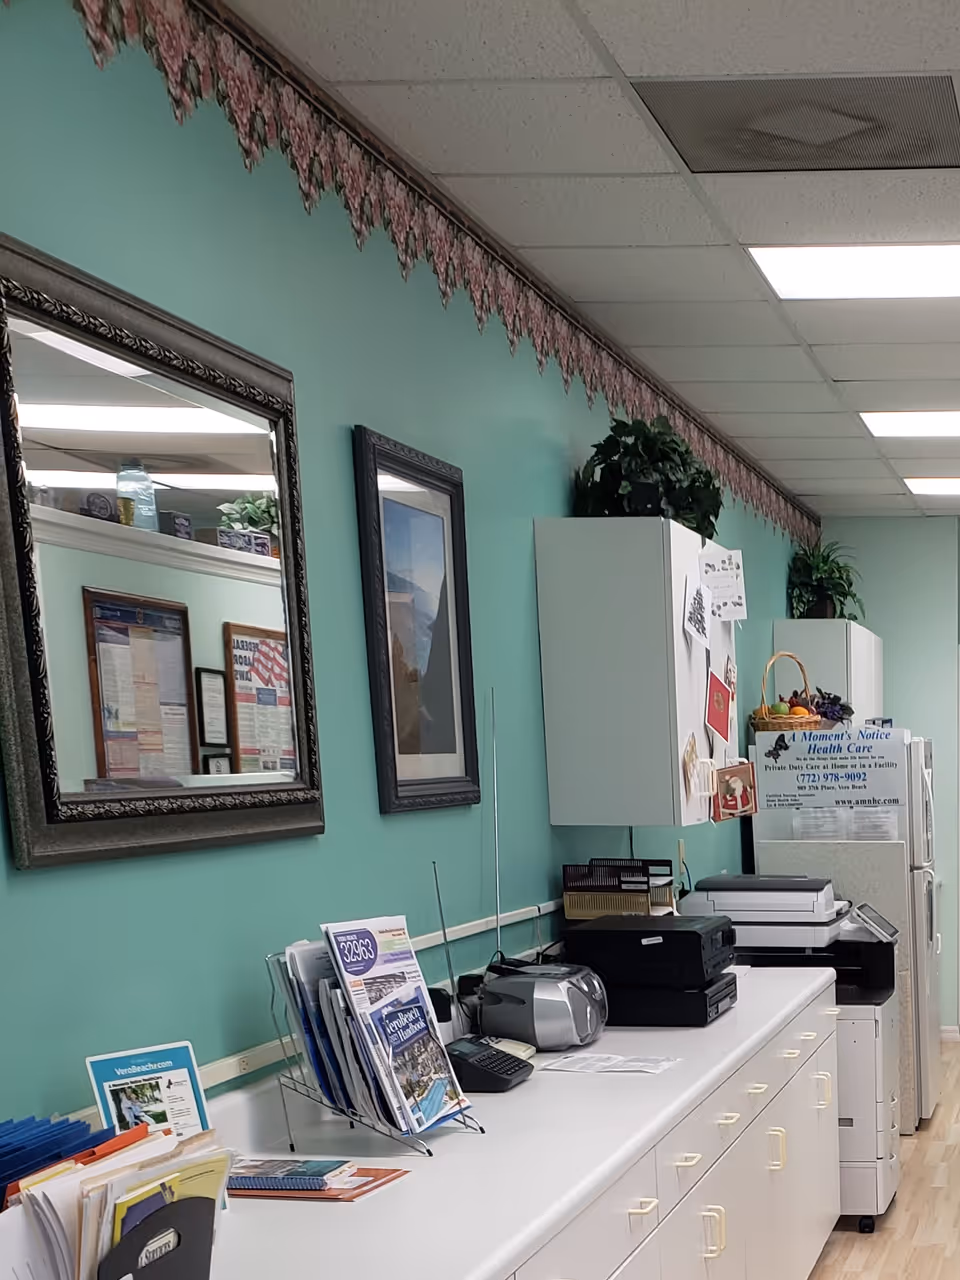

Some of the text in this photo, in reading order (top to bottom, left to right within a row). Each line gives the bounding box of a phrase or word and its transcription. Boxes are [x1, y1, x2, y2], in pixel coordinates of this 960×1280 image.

[788, 729, 891, 743] A Moment's Notice
[807, 742, 873, 755] Health Care
[764, 764, 786, 772] Private
[789, 763, 804, 772] Duty
[874, 761, 898, 769] Facility
[796, 772, 867, 783] (772) 978-9092
[834, 796, 900, 806] www.amnhc.com
[340, 938, 375, 963] 32963
